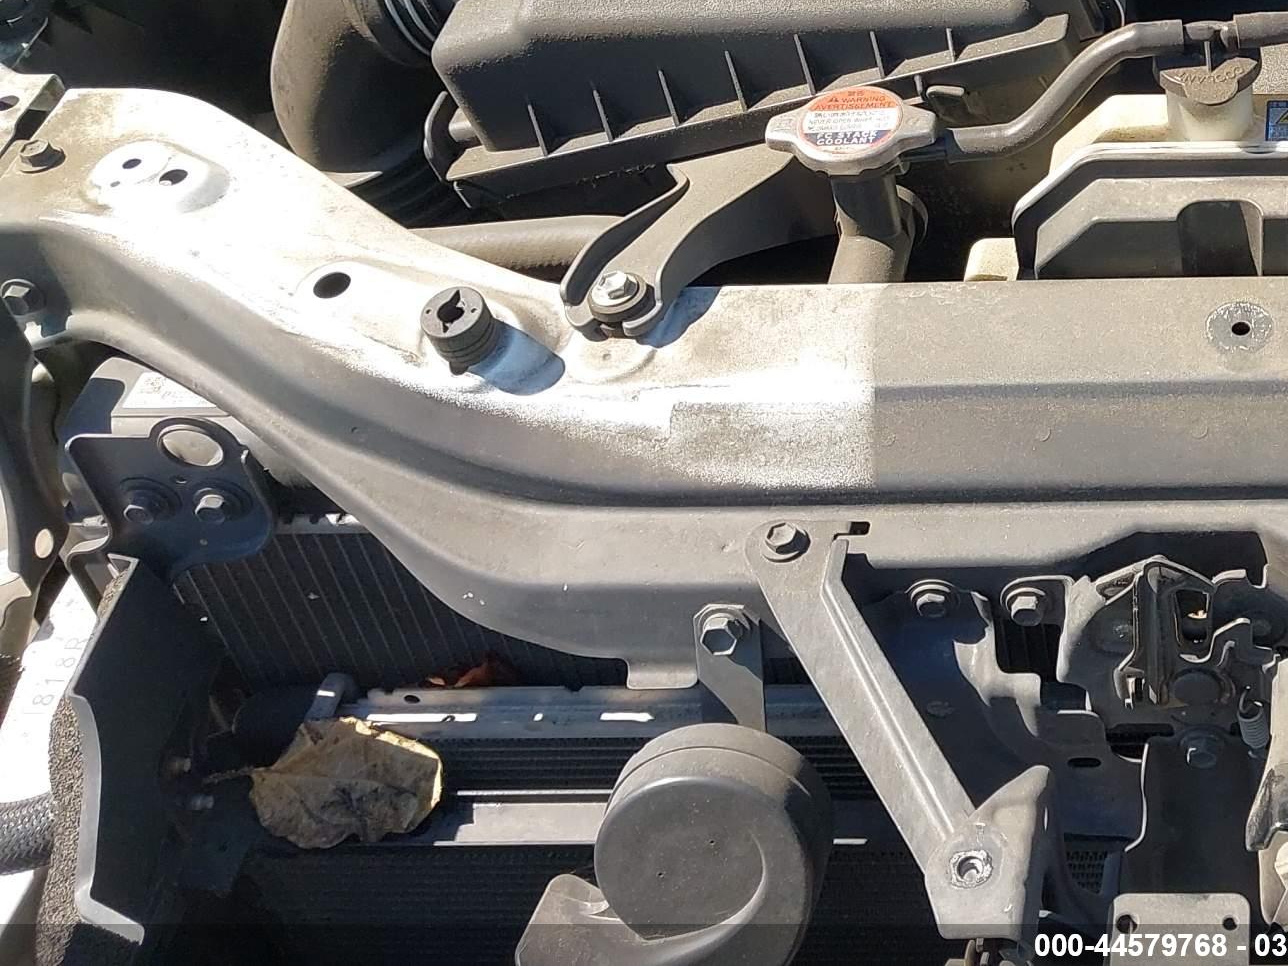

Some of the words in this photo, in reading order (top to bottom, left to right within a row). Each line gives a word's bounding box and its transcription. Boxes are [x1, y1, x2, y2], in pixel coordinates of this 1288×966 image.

[841, 96, 886, 104] WARNING
[816, 132, 833, 140] FC
[837, 130, 878, 138] STACK
[816, 137, 876, 145] COOLANT
